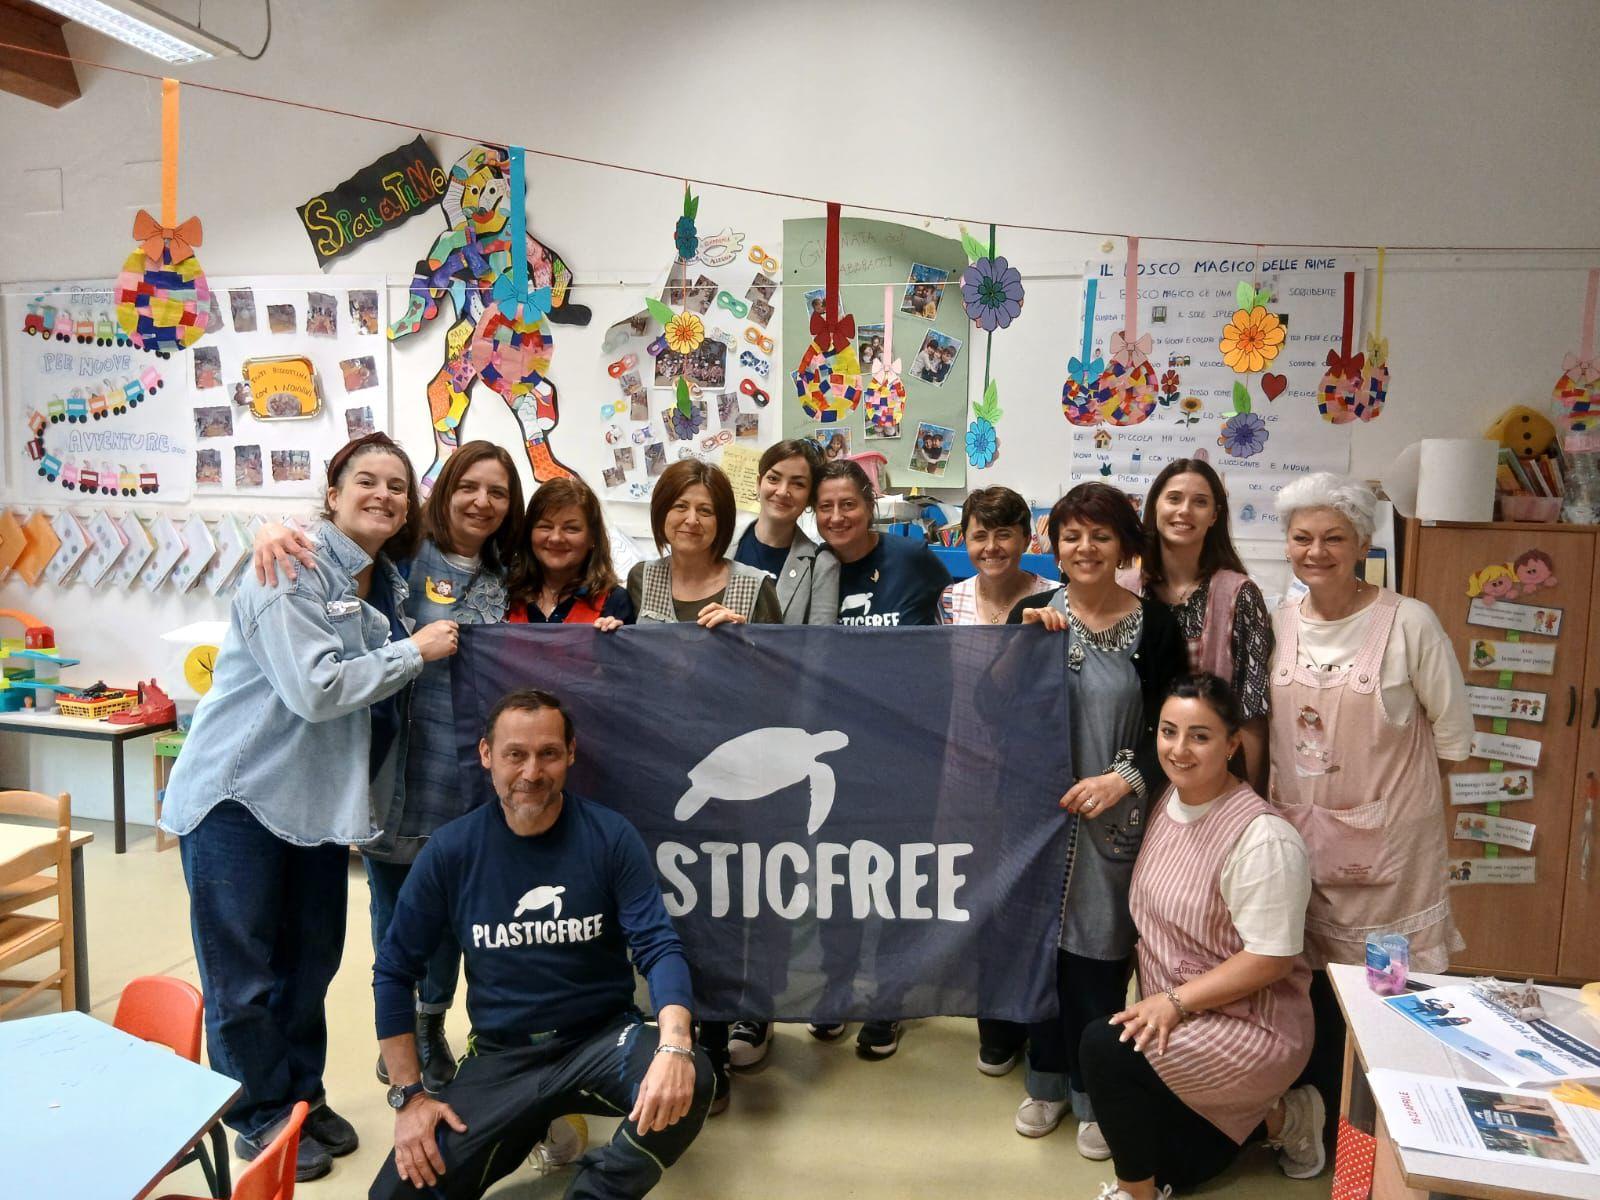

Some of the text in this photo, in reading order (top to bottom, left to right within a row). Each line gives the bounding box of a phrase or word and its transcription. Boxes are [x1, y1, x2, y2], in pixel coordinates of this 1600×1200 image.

[1100, 257, 1336, 277] IL OSCO MAGICO DELLE RIME
[43, 352, 131, 377] PER NUOVE
[656, 838, 974, 922] STICFREE
[472, 913, 604, 949] PLASTICFREE
